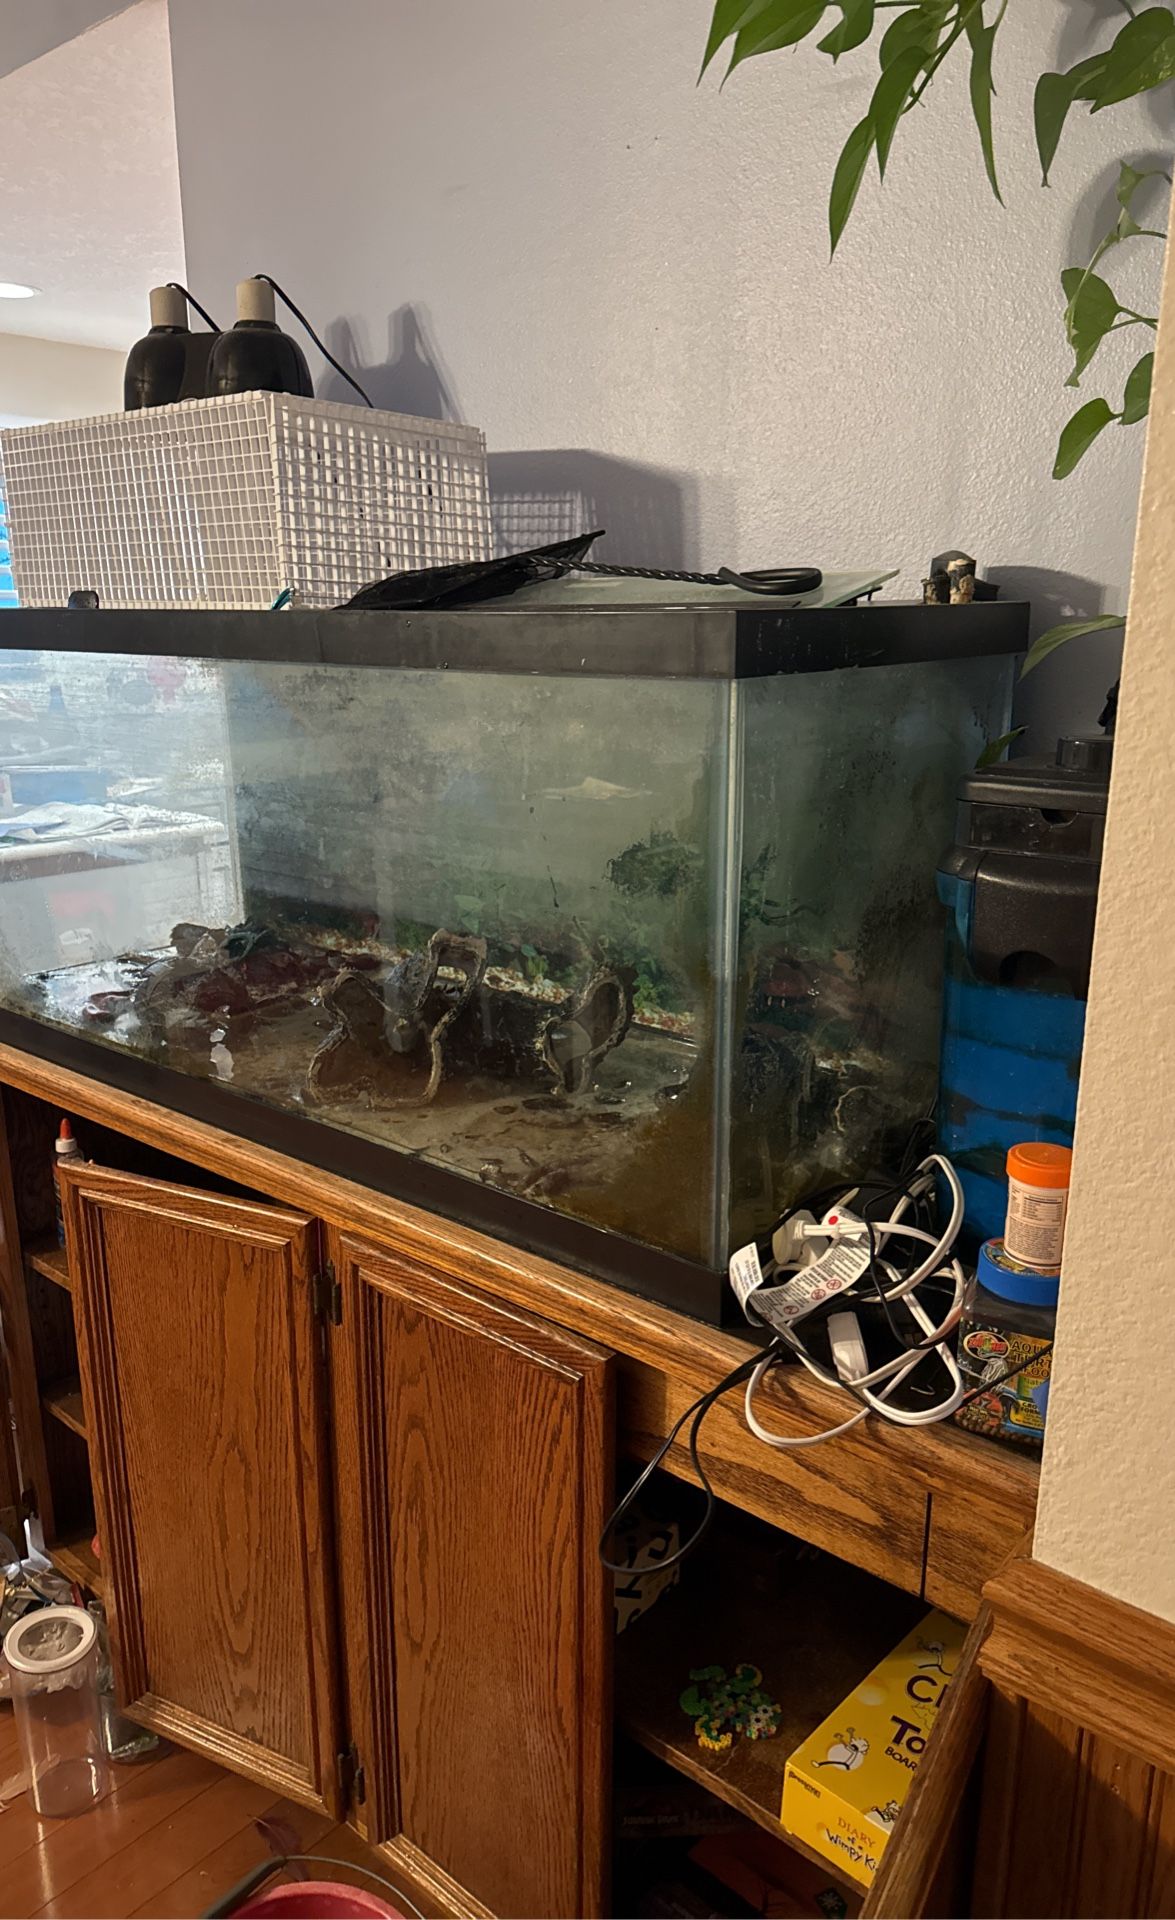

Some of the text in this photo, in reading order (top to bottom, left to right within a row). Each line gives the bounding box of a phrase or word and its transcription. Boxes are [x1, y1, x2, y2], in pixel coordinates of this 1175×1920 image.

[885, 1746, 918, 1771] BOAR
[837, 1816, 876, 1849] DIARY
[825, 1828, 878, 1871] Wimpy Ki
